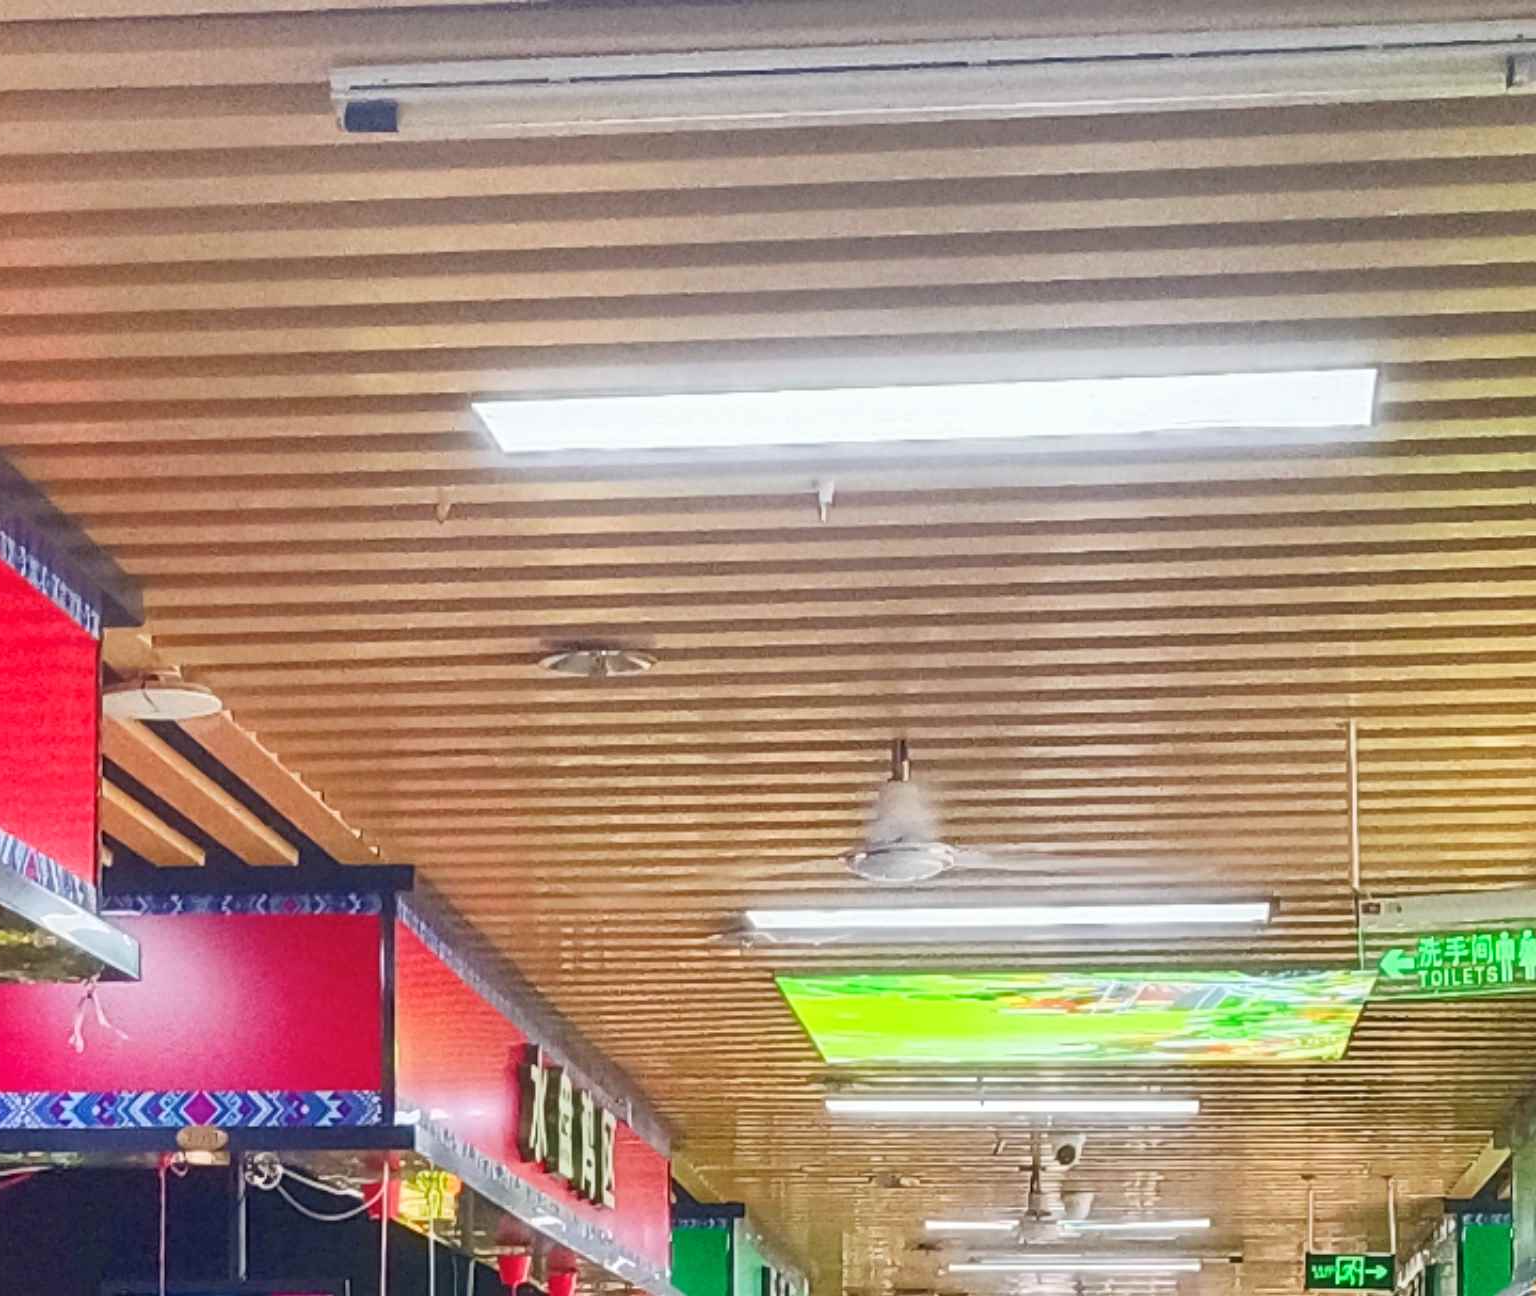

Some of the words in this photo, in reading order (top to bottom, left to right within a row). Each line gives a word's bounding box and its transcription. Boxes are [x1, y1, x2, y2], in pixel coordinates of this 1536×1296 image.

[1418, 933, 1494, 967] 洗手间
[1418, 966, 1498, 987] TOILETS
